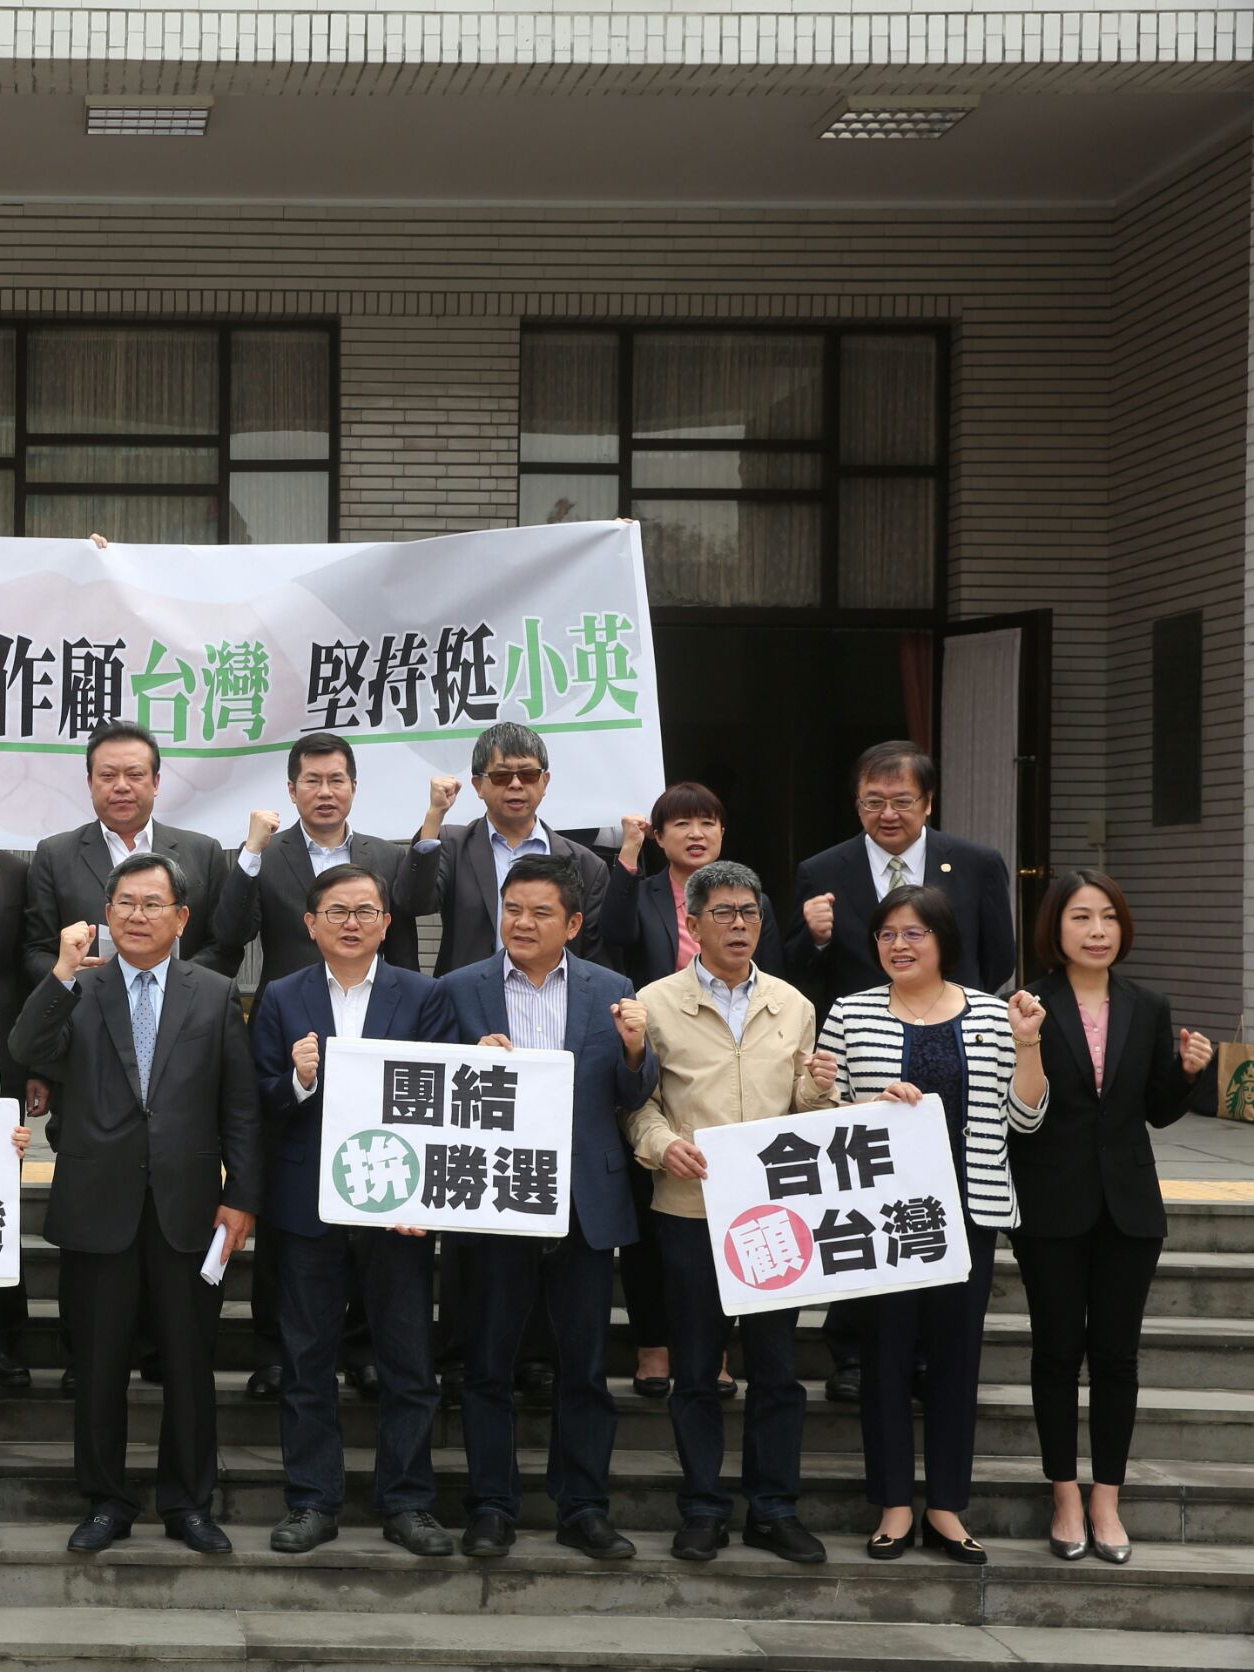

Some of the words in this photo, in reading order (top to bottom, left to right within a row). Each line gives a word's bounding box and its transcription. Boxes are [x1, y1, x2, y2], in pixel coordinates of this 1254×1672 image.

[300, 613, 639, 734] 堅持挺小英
[382, 1060, 518, 1132] 團結
[757, 1124, 896, 1200] 合作
[728, 1194, 949, 1288] 顧台灣
